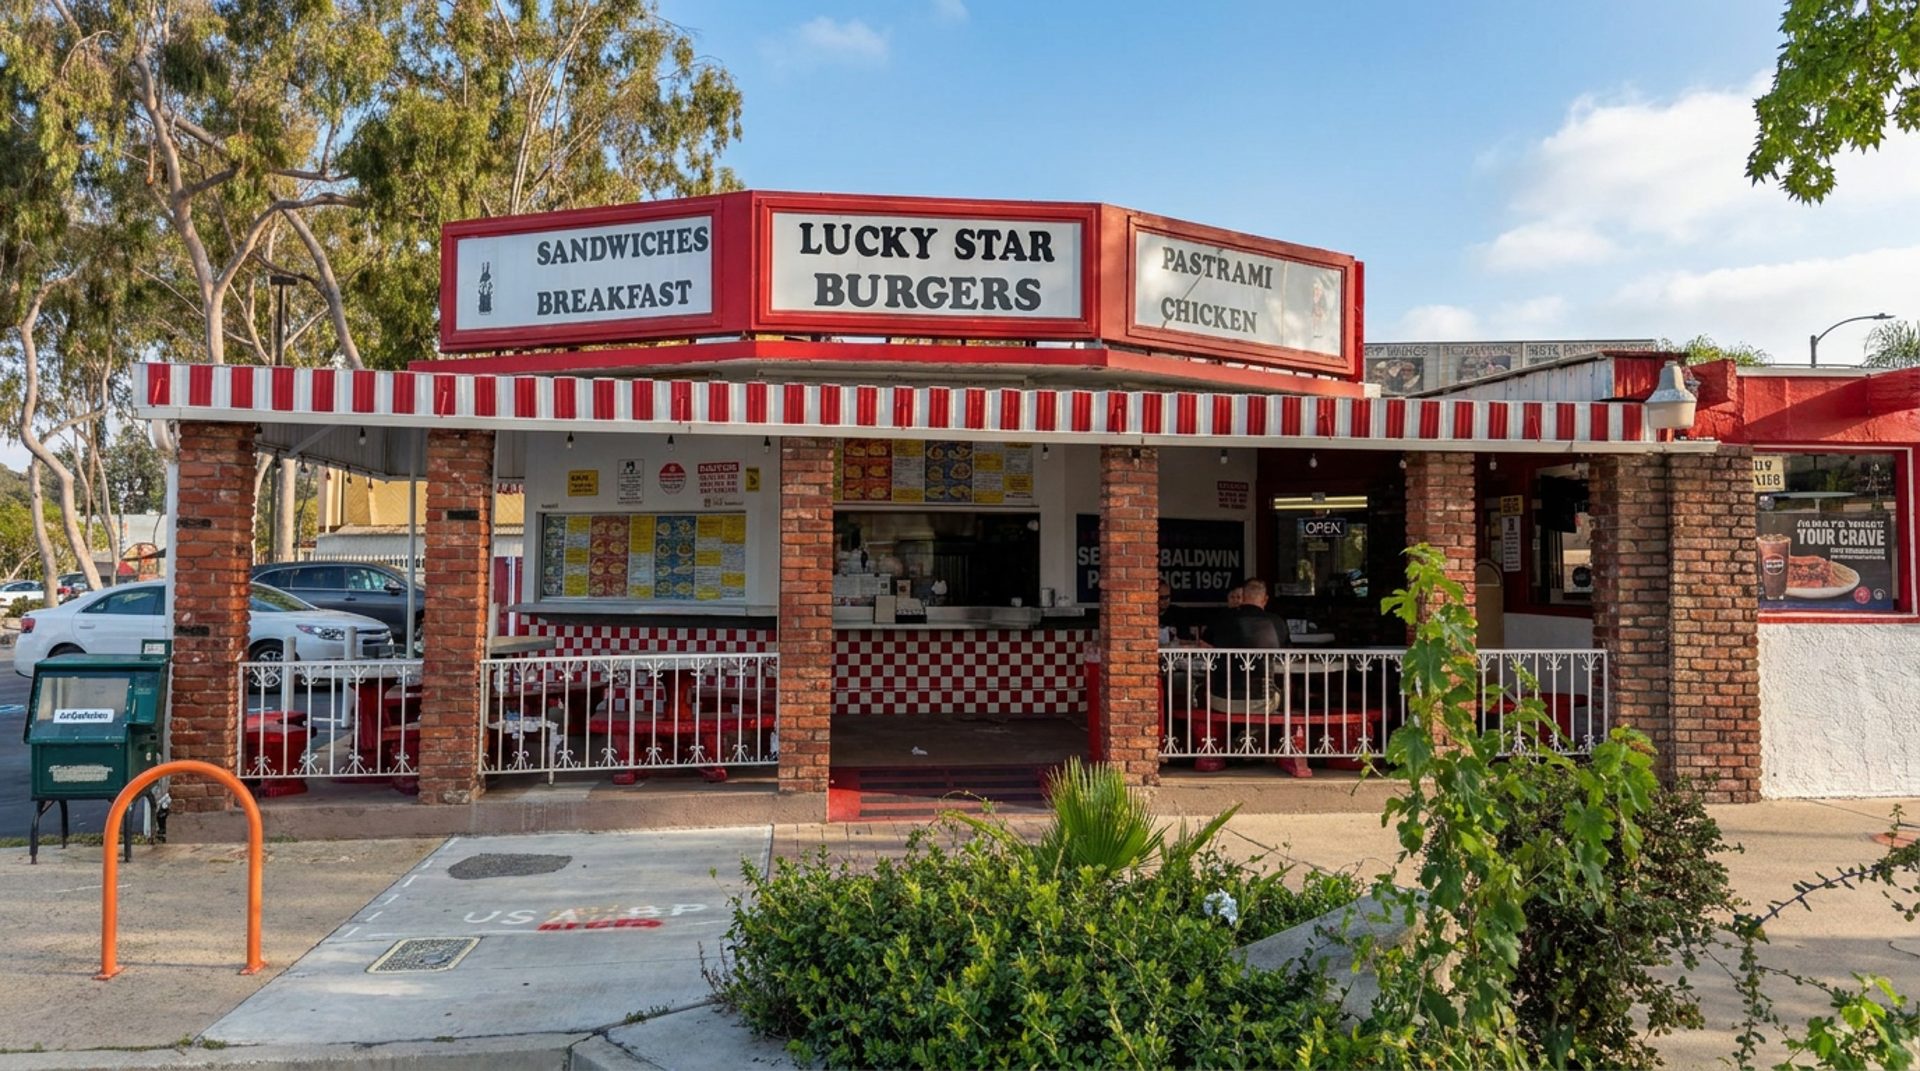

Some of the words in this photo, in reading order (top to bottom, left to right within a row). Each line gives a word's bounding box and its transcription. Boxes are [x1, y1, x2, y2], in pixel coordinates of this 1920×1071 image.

[537, 226, 709, 266] SANDWICHES
[799, 222, 938, 260] LUCKY
[954, 228, 1055, 262] STAR
[1162, 247, 1273, 289] PASTRAMI
[537, 280, 692, 315] BREAKFAST
[814, 272, 1042, 312] BURGERS
[1161, 297, 1258, 334] CHICKEN
[1305, 521, 1342, 535] OPEN
[1796, 528, 1836, 546] YOUR
[1839, 529, 1886, 547] CRAVE
[1159, 548, 1240, 569] BALDWIN
[1195, 571, 1233, 590] 1967
